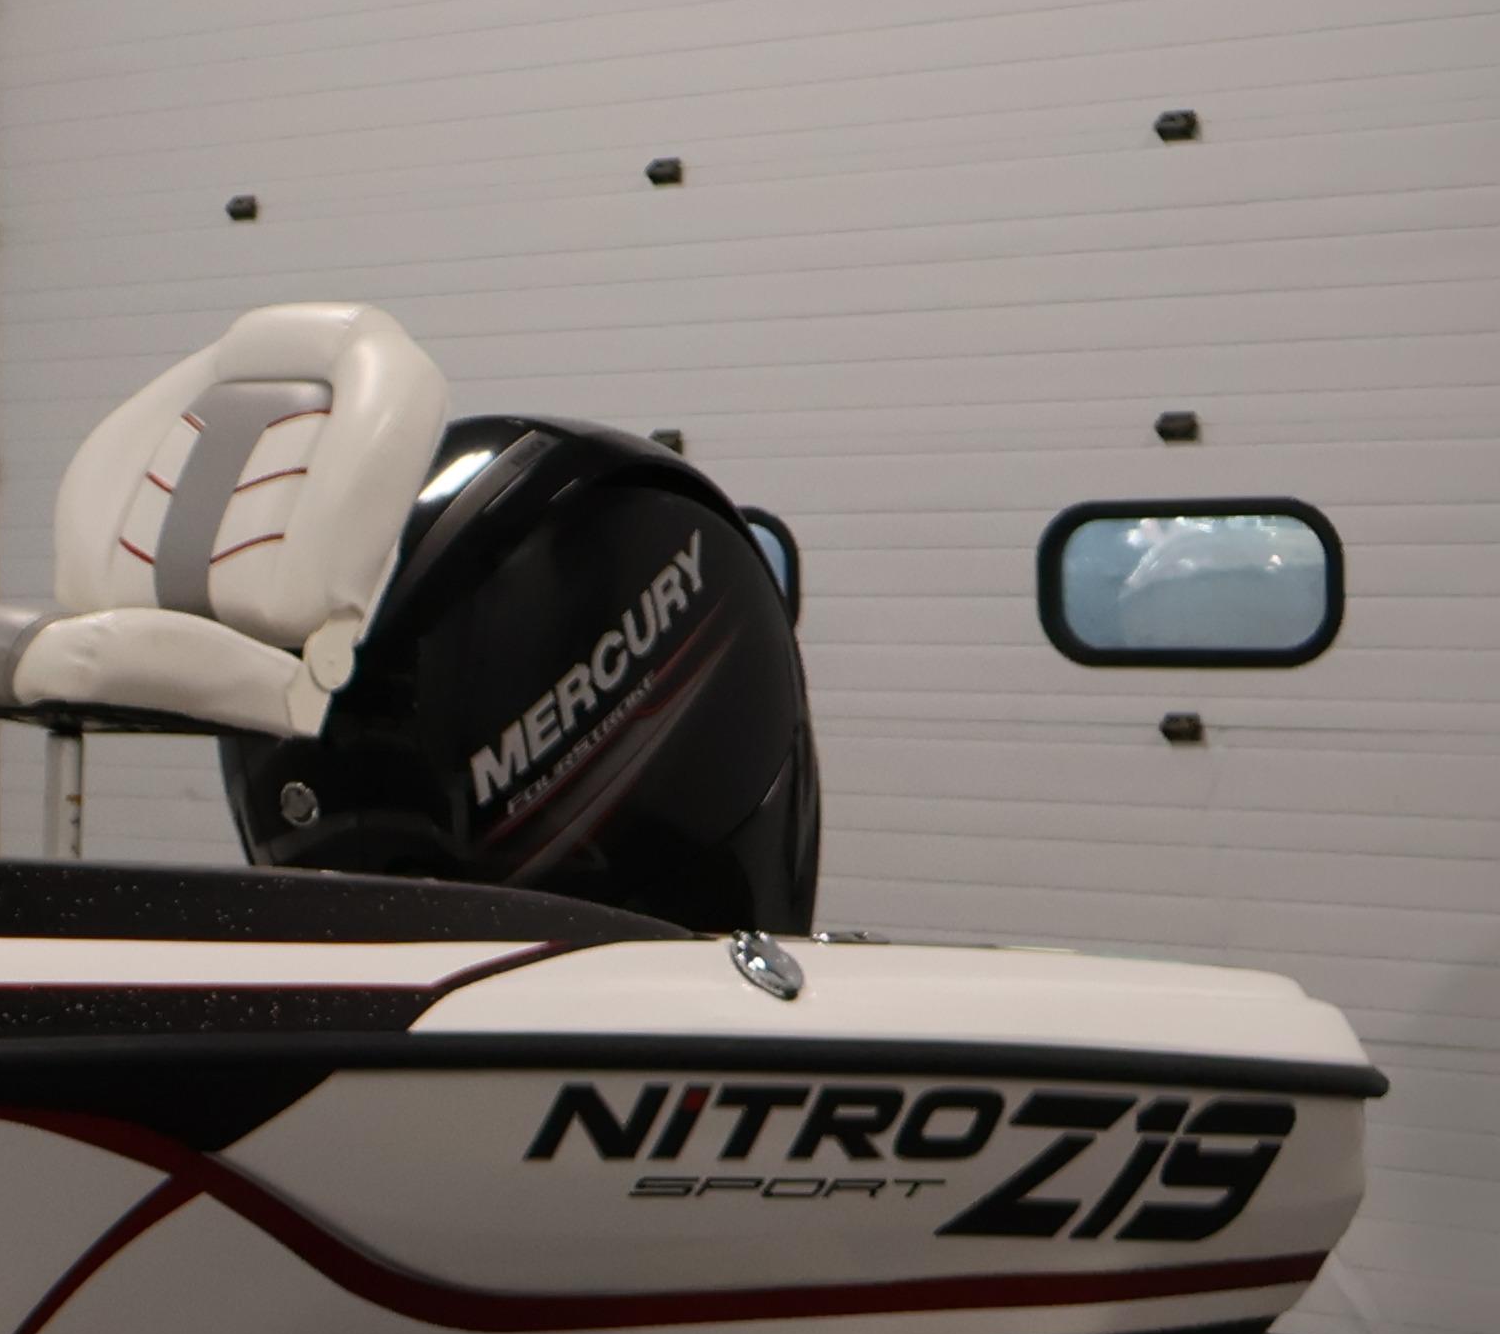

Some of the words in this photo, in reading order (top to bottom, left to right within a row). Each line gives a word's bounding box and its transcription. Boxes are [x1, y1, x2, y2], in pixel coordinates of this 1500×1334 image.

[468, 527, 703, 811] MERCURY
[522, 1081, 1007, 1162] NITRO
[933, 1088, 1298, 1243] Z19
[627, 1174, 947, 1200] SPORT
